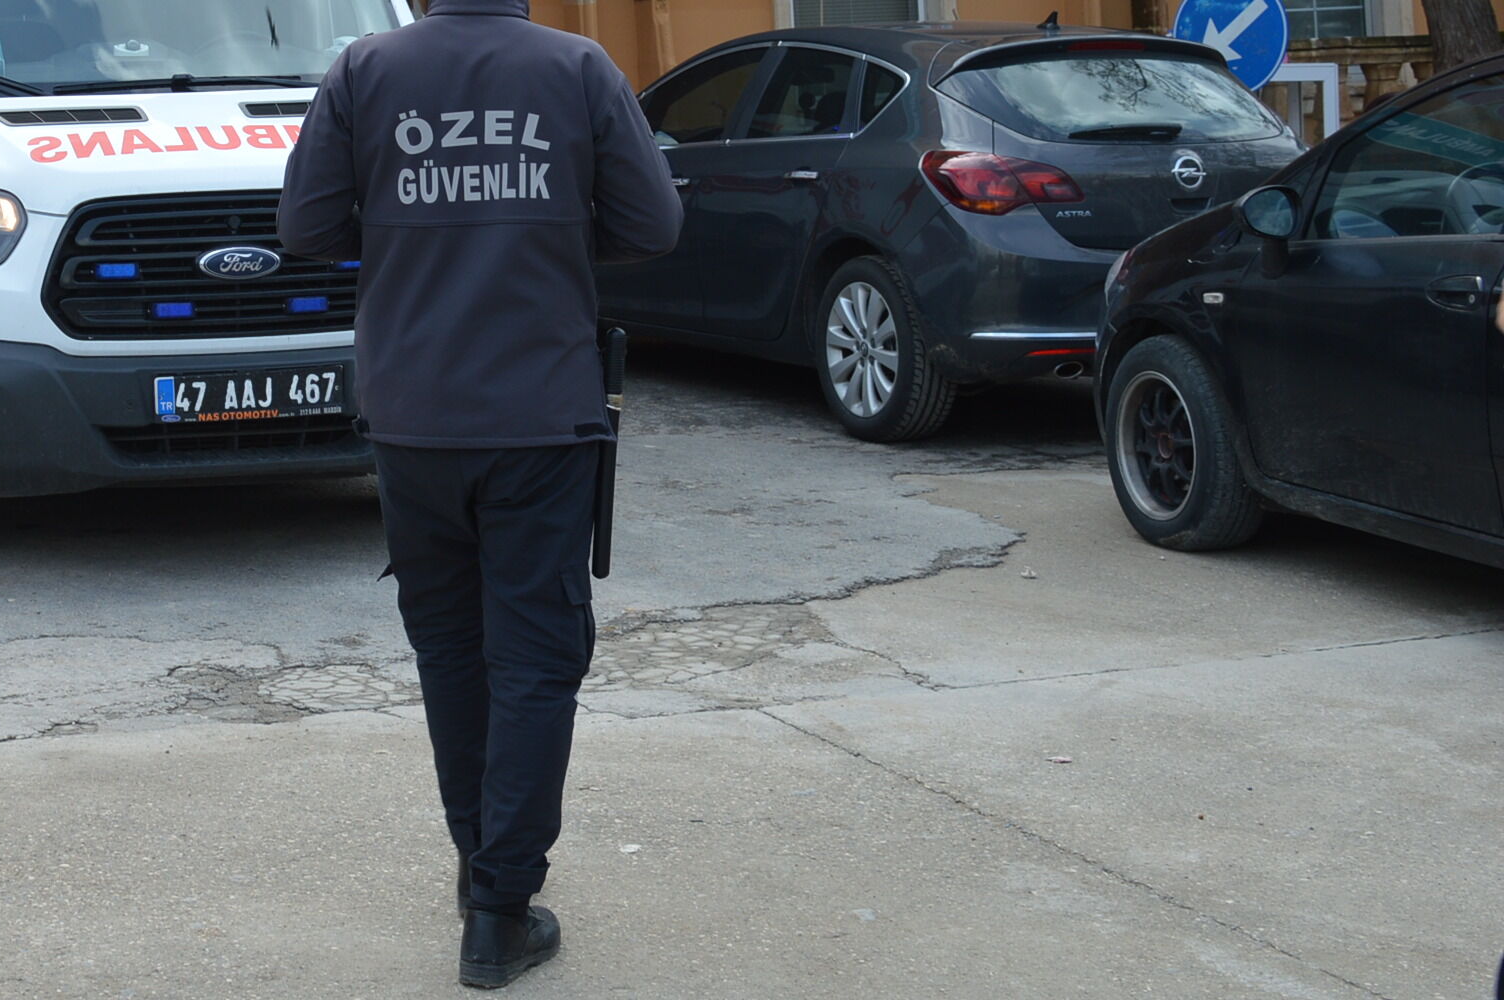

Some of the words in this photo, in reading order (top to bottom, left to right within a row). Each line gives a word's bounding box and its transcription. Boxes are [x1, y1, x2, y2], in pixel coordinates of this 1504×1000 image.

[394, 109, 551, 155] ÖZEL
[397, 153, 551, 205] GÜVENLİK
[1055, 210, 1092, 218] ASTRA
[219, 252, 264, 273] Ford
[175, 381, 207, 412] 47
[224, 376, 273, 410] AAJ
[288, 372, 336, 405] 467
[160, 401, 173, 411] TR
[198, 411, 220, 422] NAS
